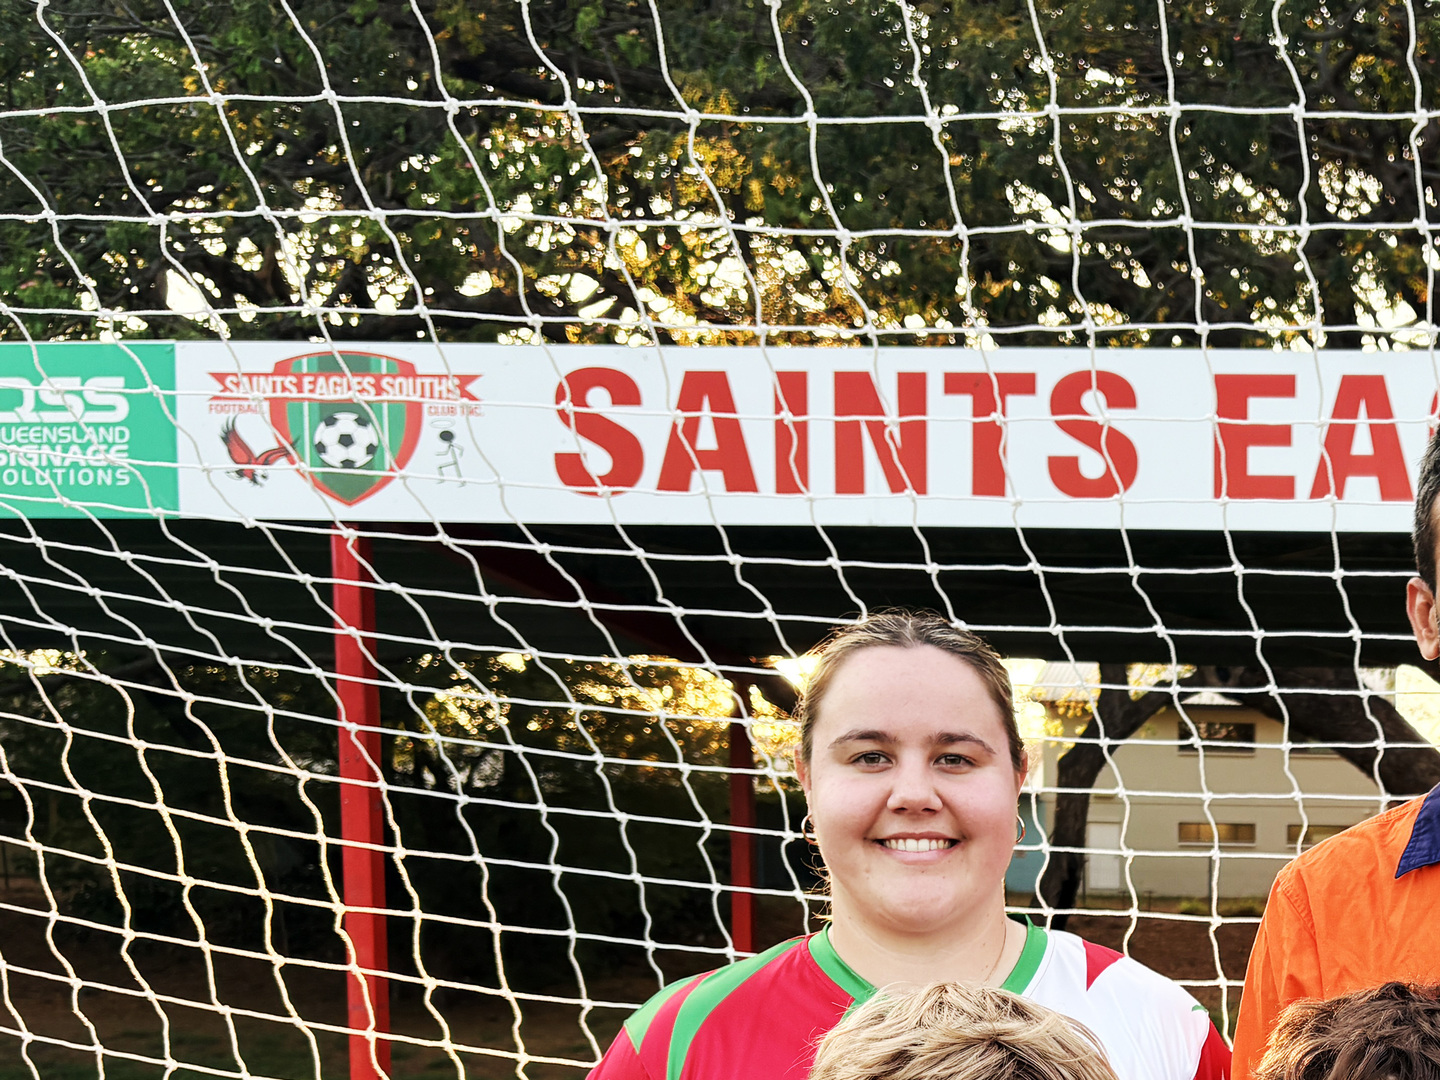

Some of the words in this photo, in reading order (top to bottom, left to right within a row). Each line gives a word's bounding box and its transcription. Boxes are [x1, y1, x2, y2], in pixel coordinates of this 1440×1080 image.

[223, 375, 299, 395] SAINTS
[302, 376, 377, 397] EAGLES
[381, 376, 461, 399] SOUTHS
[208, 403, 264, 414] FOOTBAL
[427, 405, 457, 416] CLUB
[553, 366, 1139, 498] SAINTS
